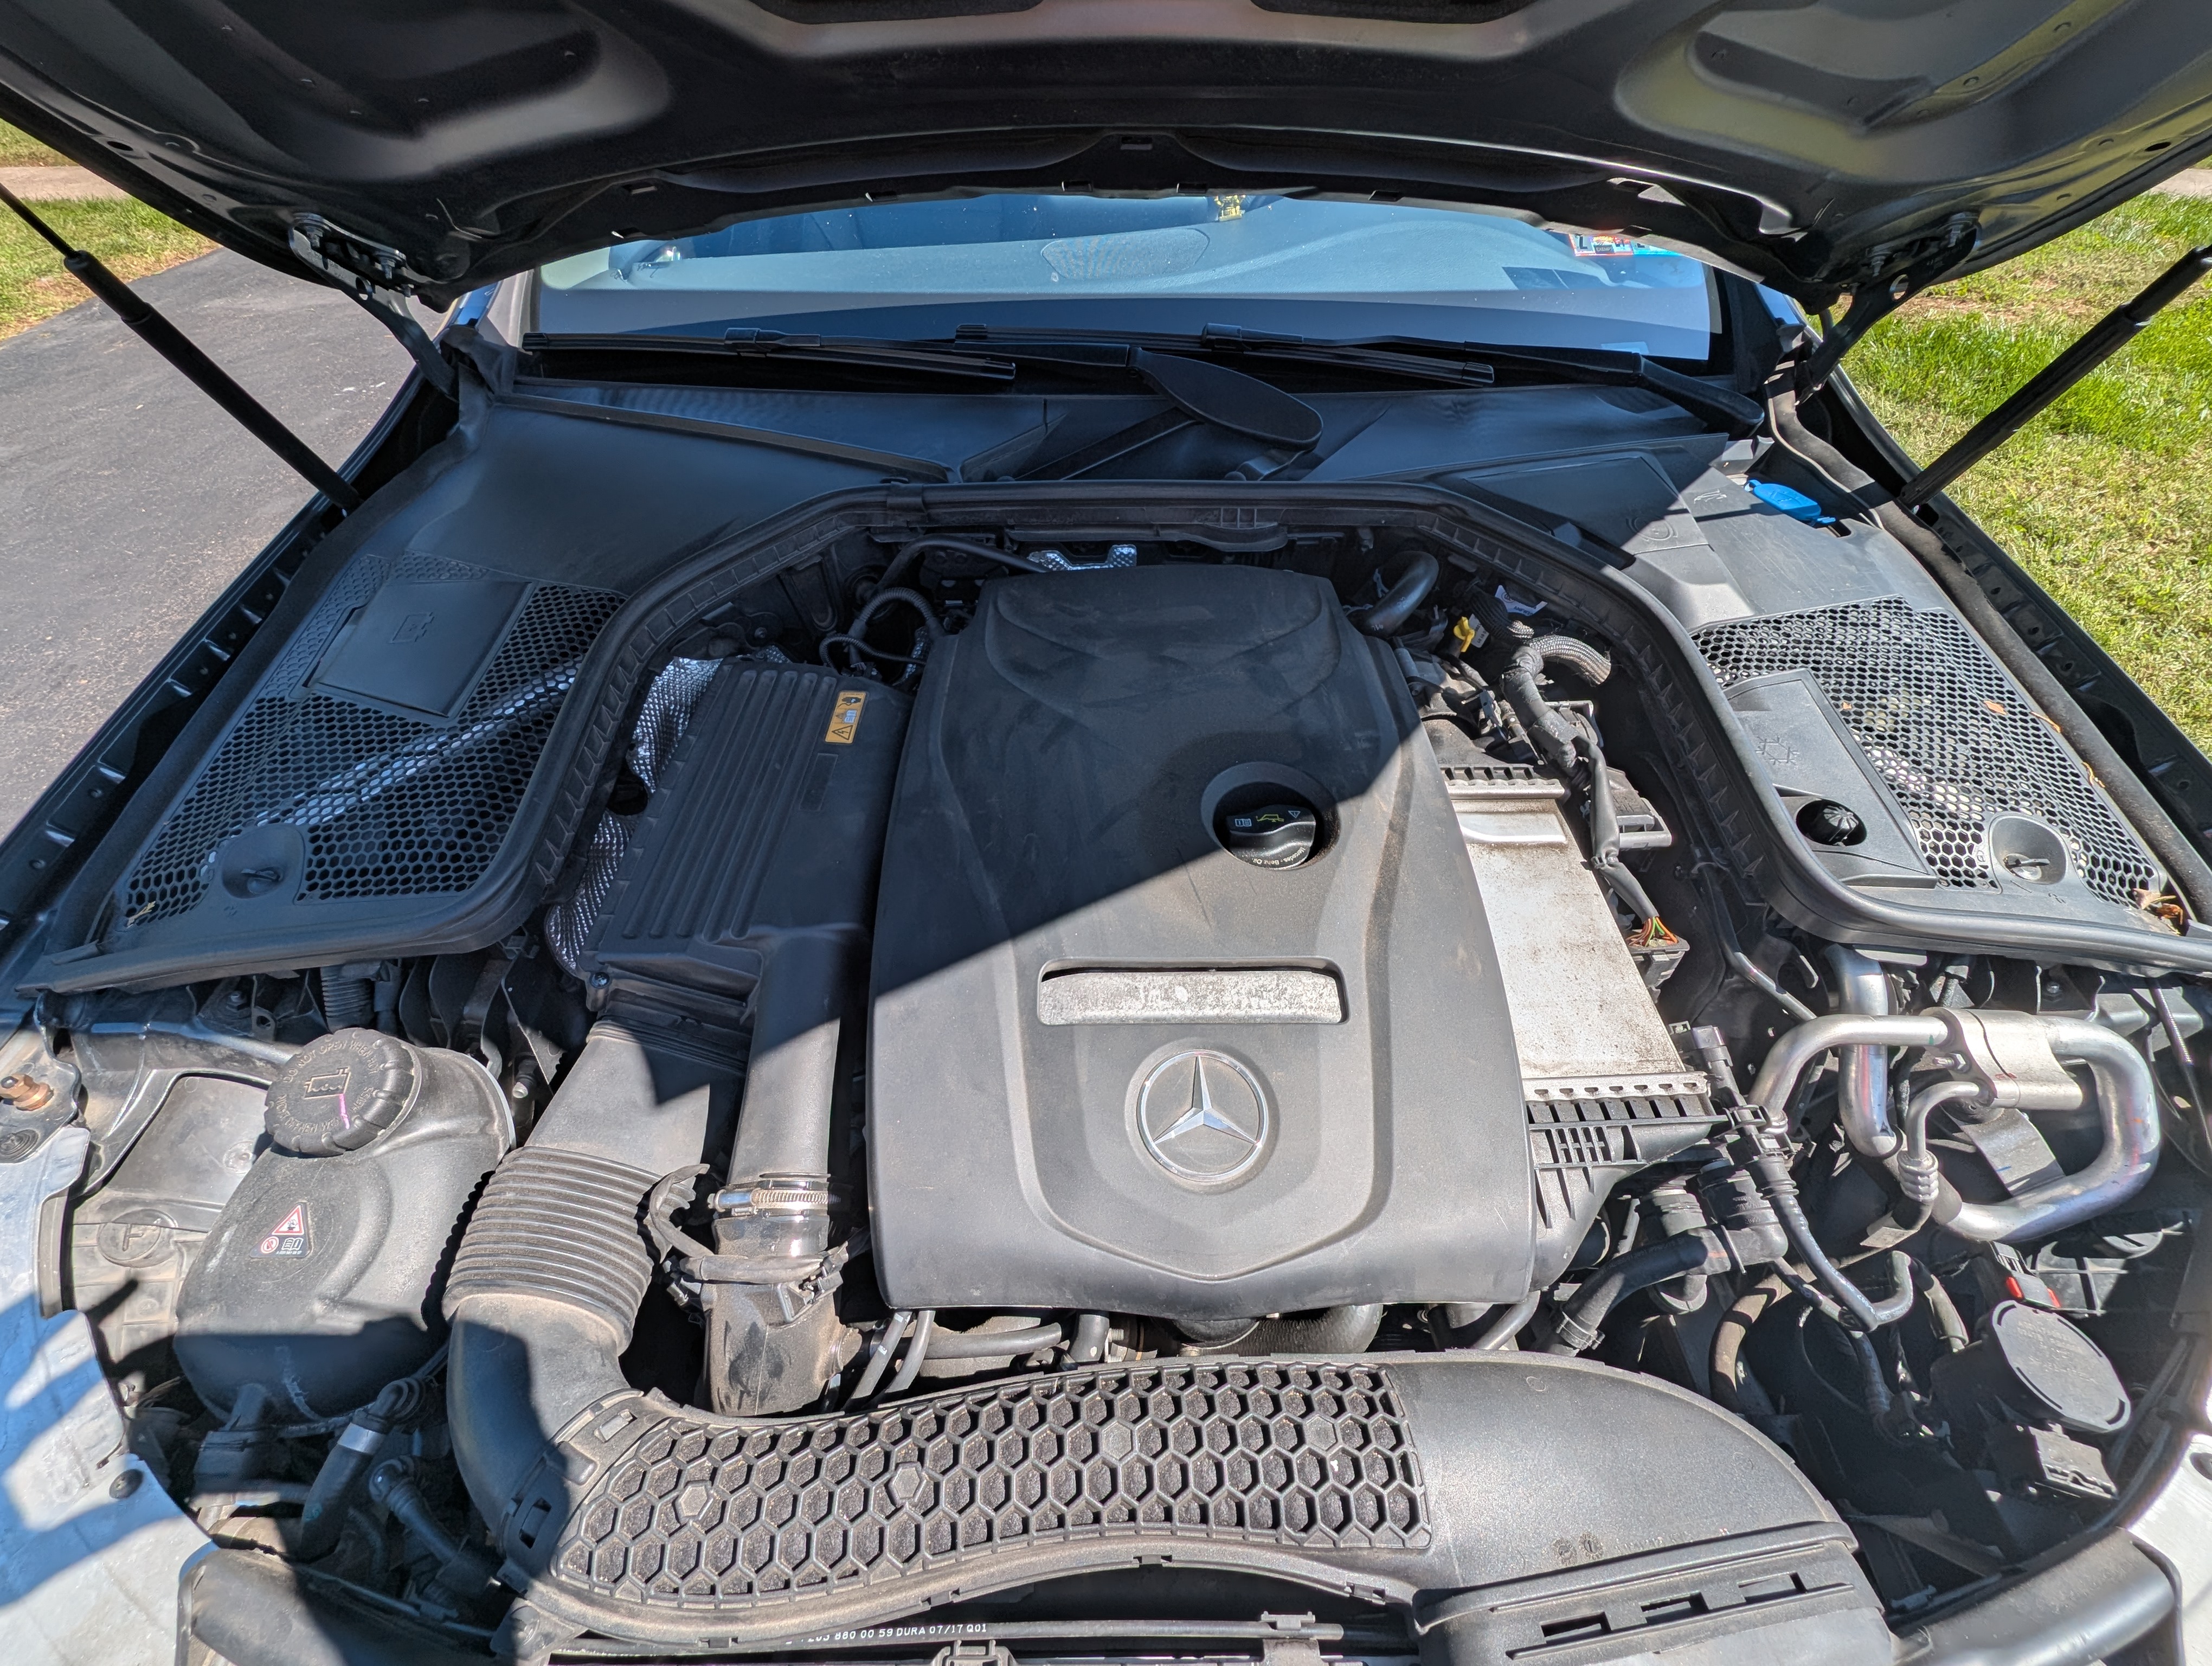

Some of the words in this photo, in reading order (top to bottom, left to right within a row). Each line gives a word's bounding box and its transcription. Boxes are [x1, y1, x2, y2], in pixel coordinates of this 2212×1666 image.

[283, 1068, 298, 1082] DO
[297, 1050, 316, 1067] NOT
[319, 1040, 347, 1054] OPEN
[349, 1040, 373, 1057] WHEN
[367, 1056, 380, 1074] HOT
[350, 1087, 374, 1113] HEISS
[835, 1631, 856, 1640] 880
[860, 1630, 874, 1639] 00
[879, 1628, 893, 1637] 59
[896, 1627, 925, 1636] DURA
[929, 1625, 962, 1634] 07/17
[967, 1623, 987, 1633] Q01
